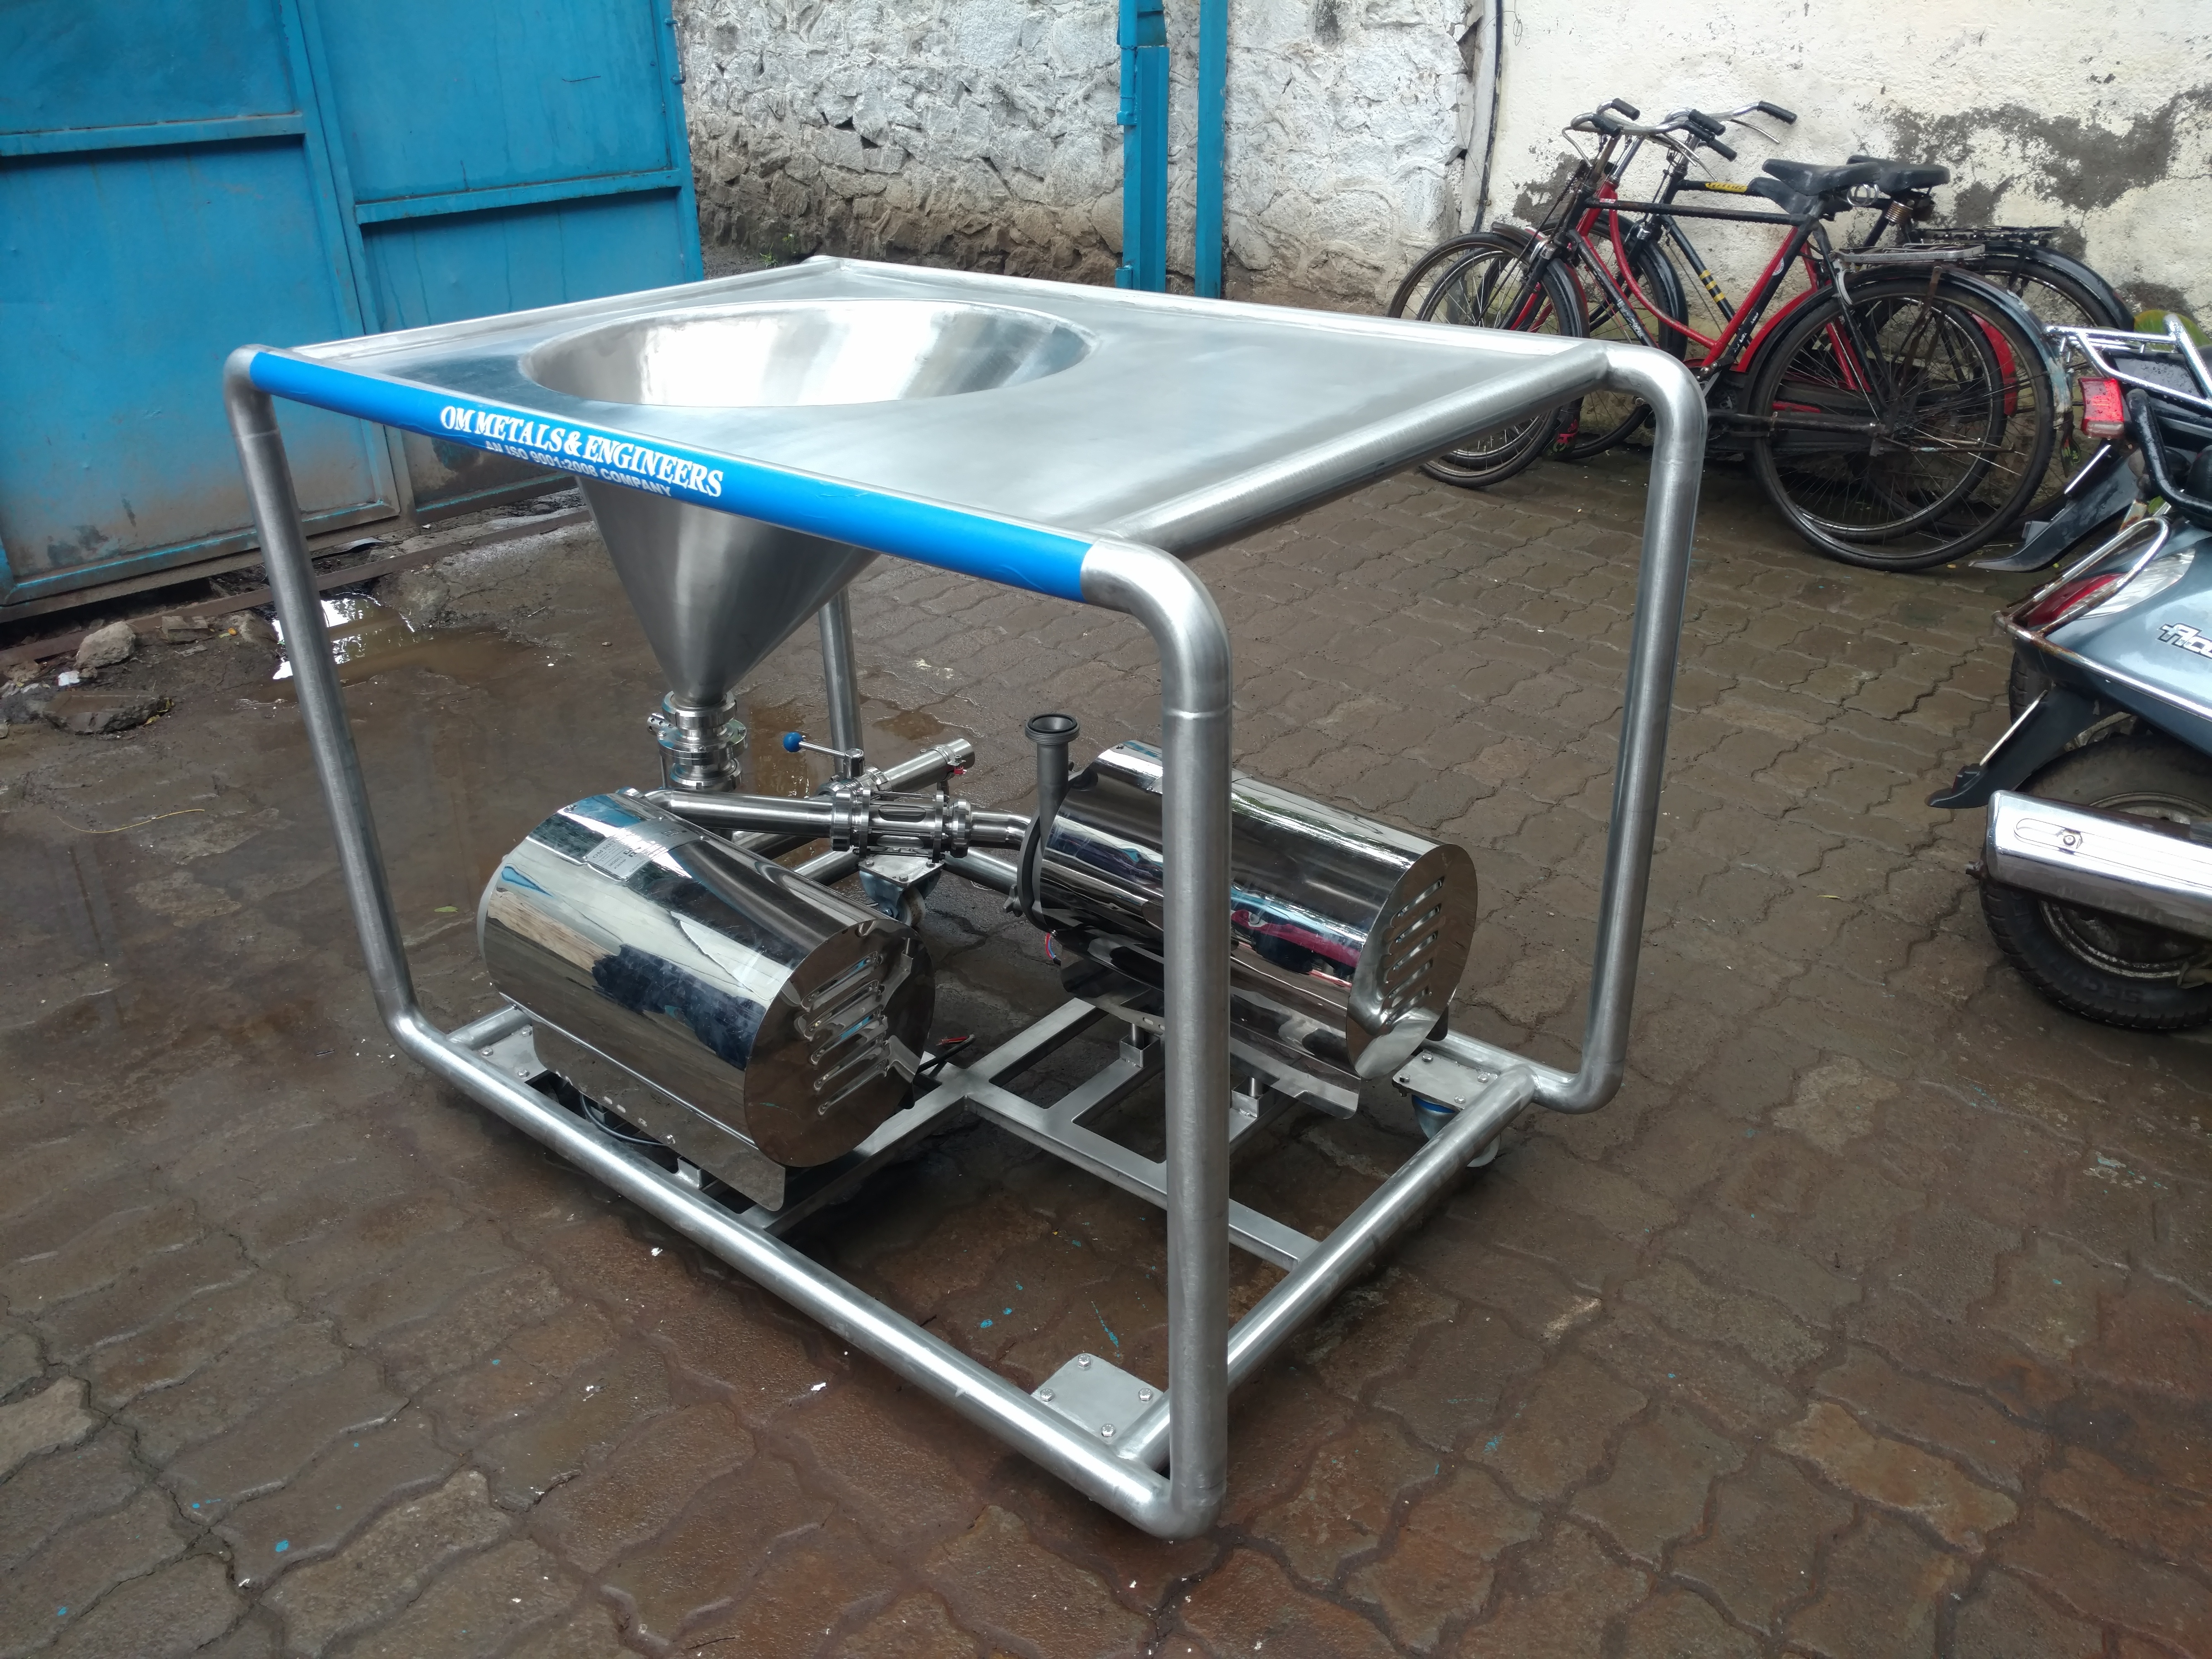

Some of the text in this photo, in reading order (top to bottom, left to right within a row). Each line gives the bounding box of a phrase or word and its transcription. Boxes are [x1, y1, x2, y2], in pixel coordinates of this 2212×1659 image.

[440, 406, 724, 498] OM METALS & ENGINEERS
[504, 445, 529, 460] ISO
[529, 450, 599, 477] 9001:2008
[600, 468, 672, 497] COMPANY
[629, 859, 646, 872] CAUTION
